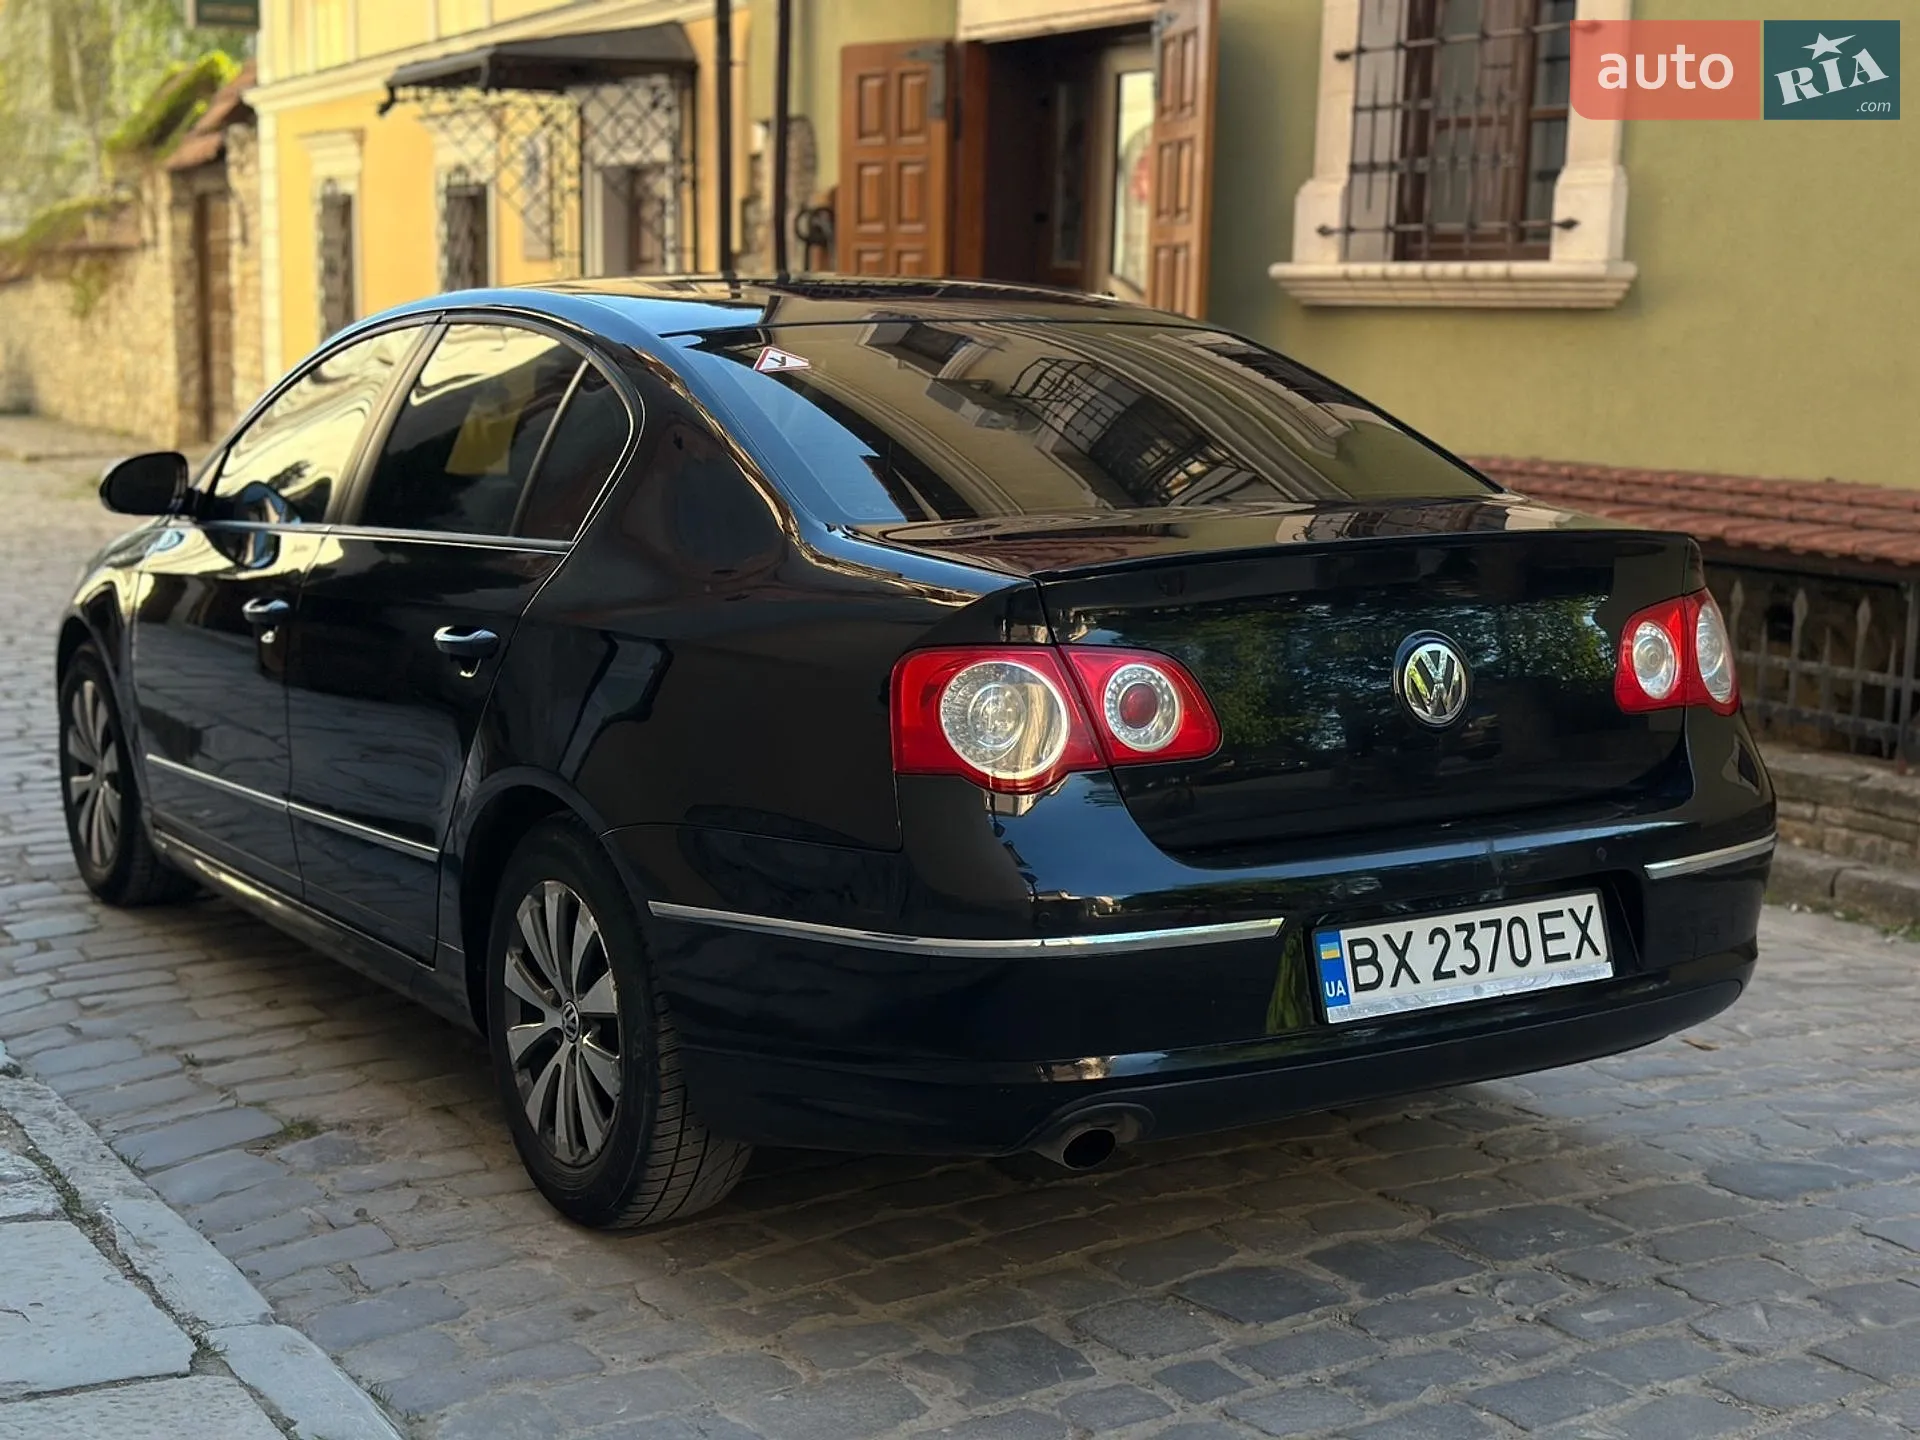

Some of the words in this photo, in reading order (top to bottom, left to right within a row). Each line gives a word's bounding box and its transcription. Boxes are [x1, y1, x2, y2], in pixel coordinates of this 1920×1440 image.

[1347, 931, 1421, 993] BX
[1428, 916, 1532, 981] 2370
[1537, 905, 1601, 964] EX
[1325, 979, 1347, 998] UA
